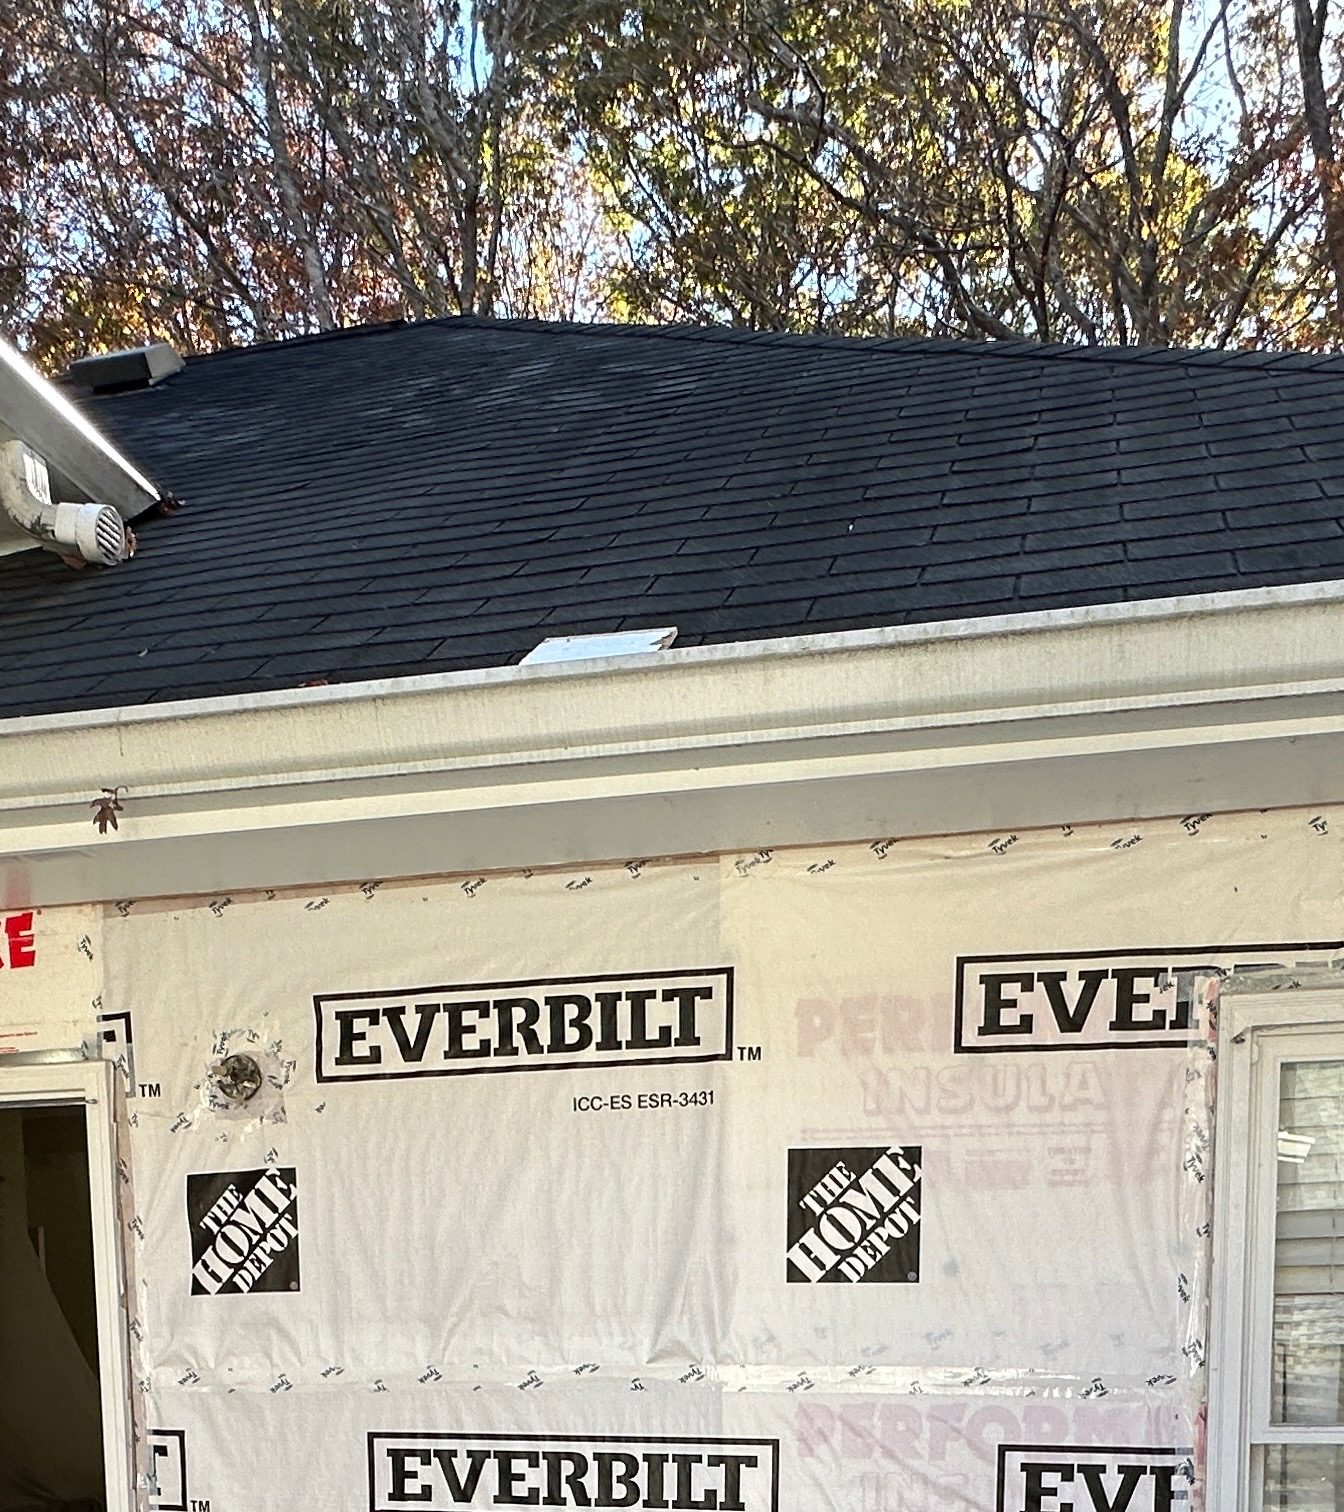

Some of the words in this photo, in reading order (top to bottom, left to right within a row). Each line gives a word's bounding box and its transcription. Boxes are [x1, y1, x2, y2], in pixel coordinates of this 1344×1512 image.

[992, 834, 1020, 855] Tyvek
[333, 986, 713, 1067] EVERBILT
[737, 1046, 762, 1062] TM
[572, 1092, 633, 1112] ICC-ES
[637, 1090, 715, 1111] ESR-3431
[799, 1160, 856, 1218] THE
[1186, 1156, 1205, 1184] Tyvek
[192, 1168, 298, 1295] HOME
[199, 1183, 241, 1237] THE
[786, 1146, 923, 1284] HOME
[837, 1199, 923, 1282] DEPOT
[231, 1213, 300, 1294] DEPOT
[786, 1377, 813, 1393] Tyvek
[386, 1447, 758, 1512] EVERBILT
